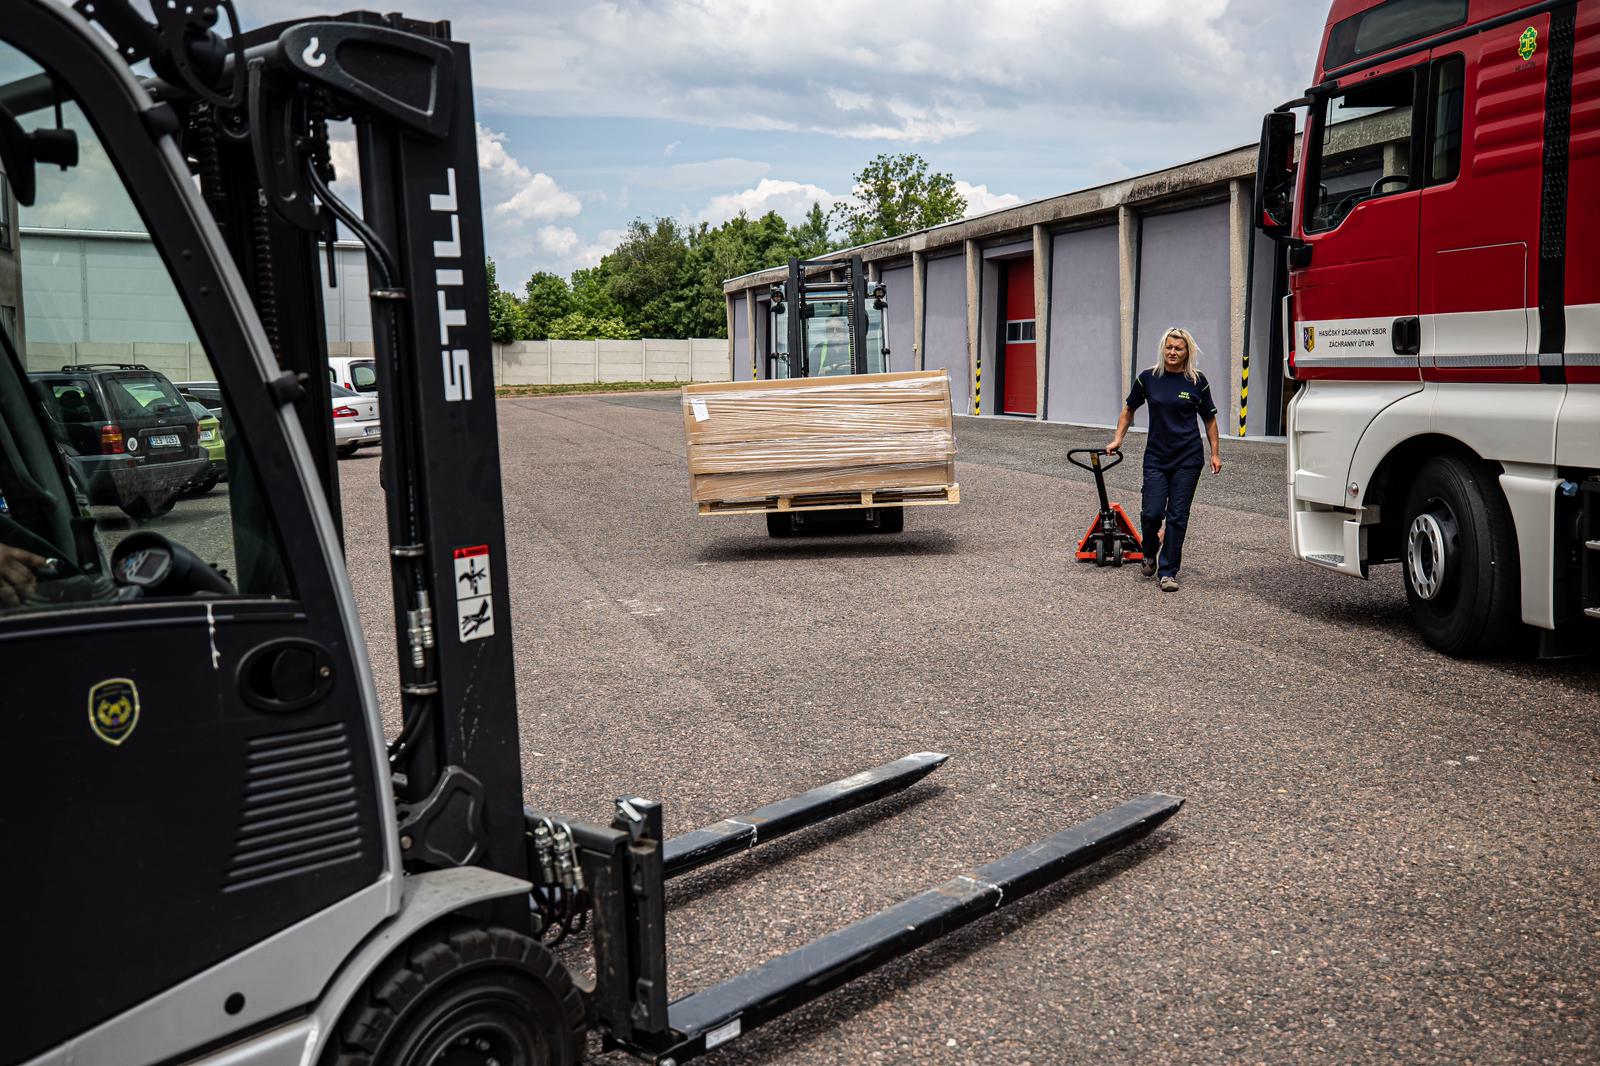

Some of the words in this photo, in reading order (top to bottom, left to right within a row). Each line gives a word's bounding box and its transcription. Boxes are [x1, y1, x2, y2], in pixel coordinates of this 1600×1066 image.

[429, 168, 472, 402] STILL
[1318, 328, 1340, 337] HASIČSKÝ
[1341, 327, 1371, 336] ZÁCHRANNÝ
[1371, 327, 1387, 335] SBOR
[1328, 339, 1357, 348] ZÁCHRANNÝ
[1357, 339, 1375, 347] ÚTVAR
